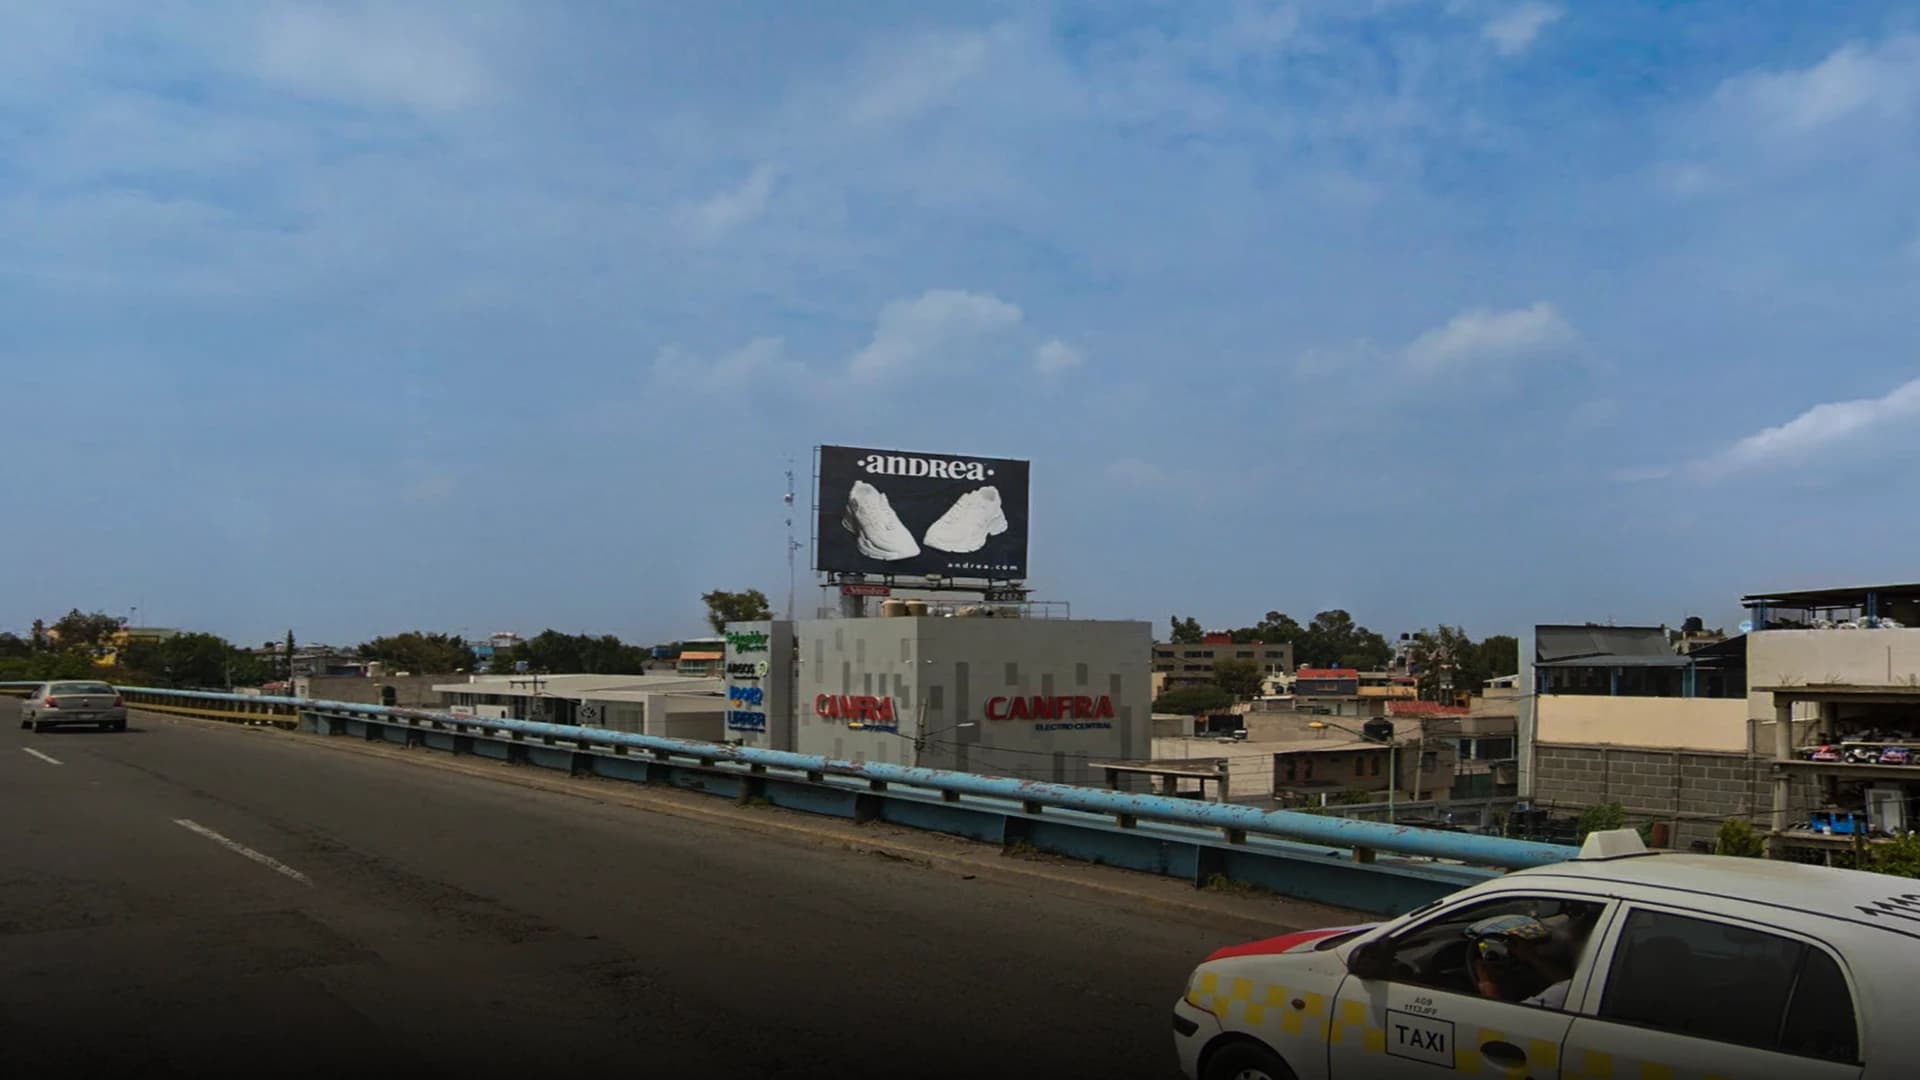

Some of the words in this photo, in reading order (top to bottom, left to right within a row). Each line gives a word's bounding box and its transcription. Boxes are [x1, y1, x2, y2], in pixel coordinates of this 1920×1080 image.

[815, 693, 897, 722] CANFRA
[985, 695, 1115, 721] CANFRA
[1395, 1024, 1445, 1053] TAXI
